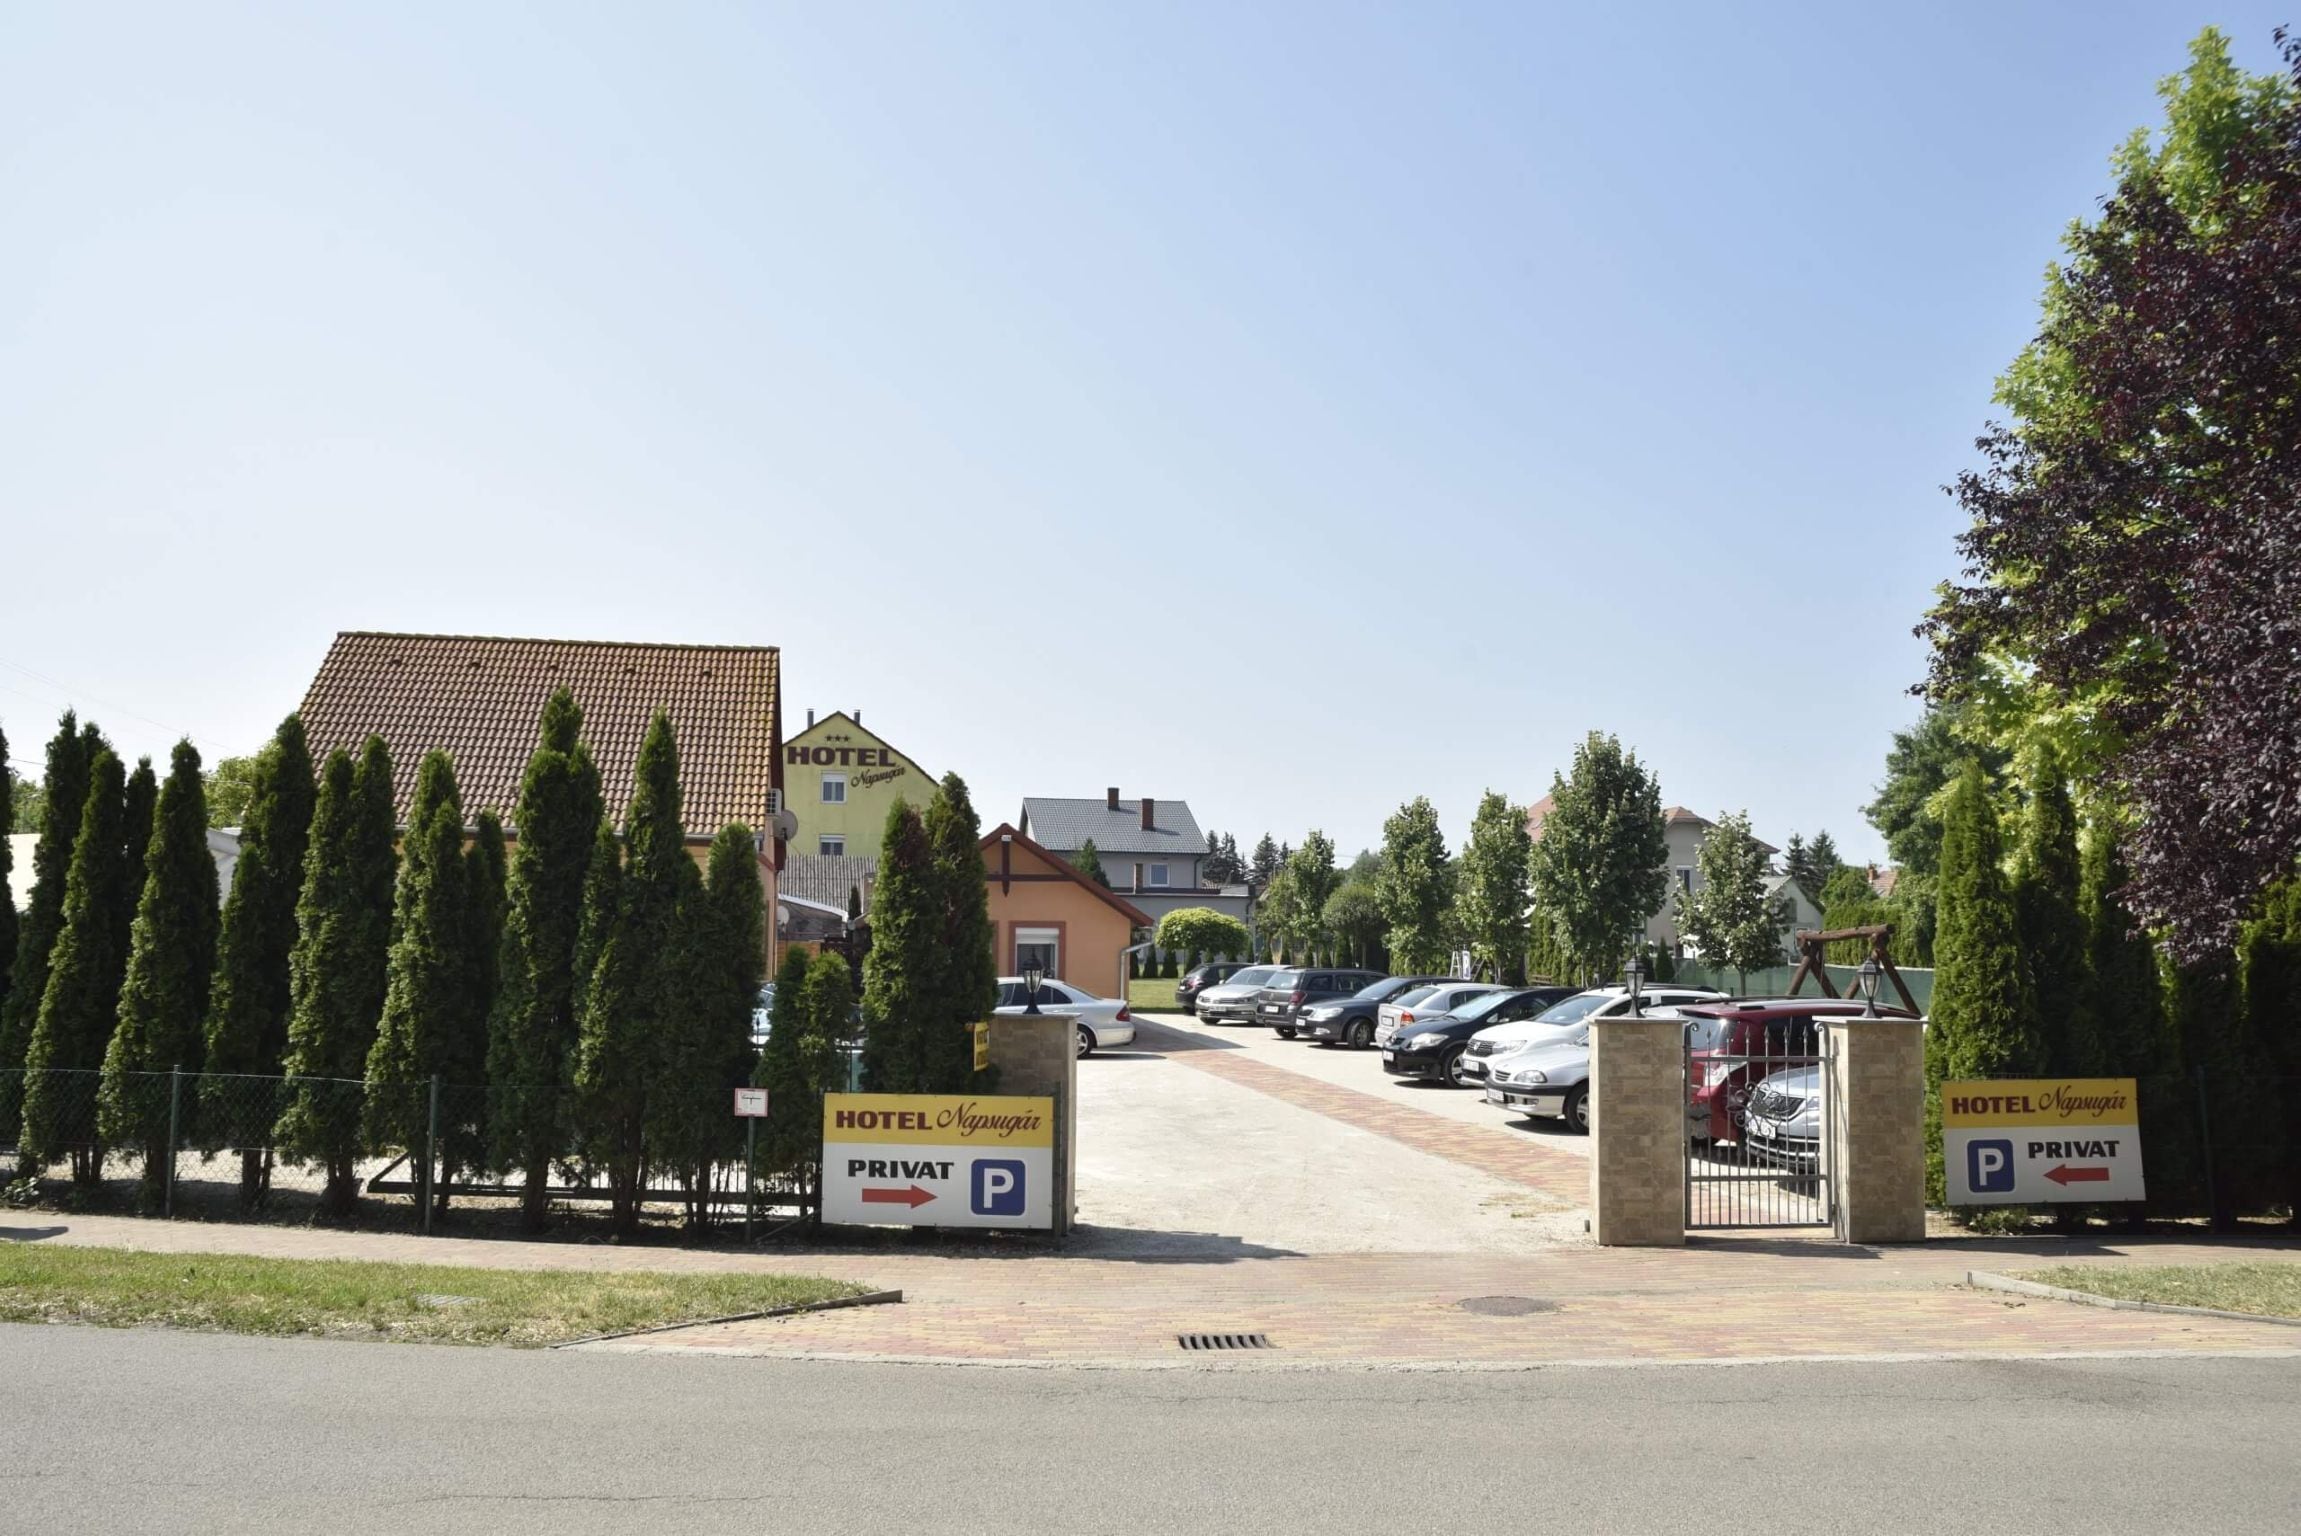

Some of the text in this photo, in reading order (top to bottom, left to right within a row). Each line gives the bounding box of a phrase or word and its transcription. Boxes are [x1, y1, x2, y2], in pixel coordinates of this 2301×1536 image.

[787, 746, 896, 767] HOTEL
[1952, 1085, 2127, 1118] HOTEL Napsugár
[836, 1102, 1041, 1137] HOTEL Napsugár
[2028, 1140, 2120, 1159] PRIVAT
[848, 1159, 954, 1179] PRIVAT
[1978, 1148, 2004, 1186] P
[983, 1168, 1015, 1209] P
